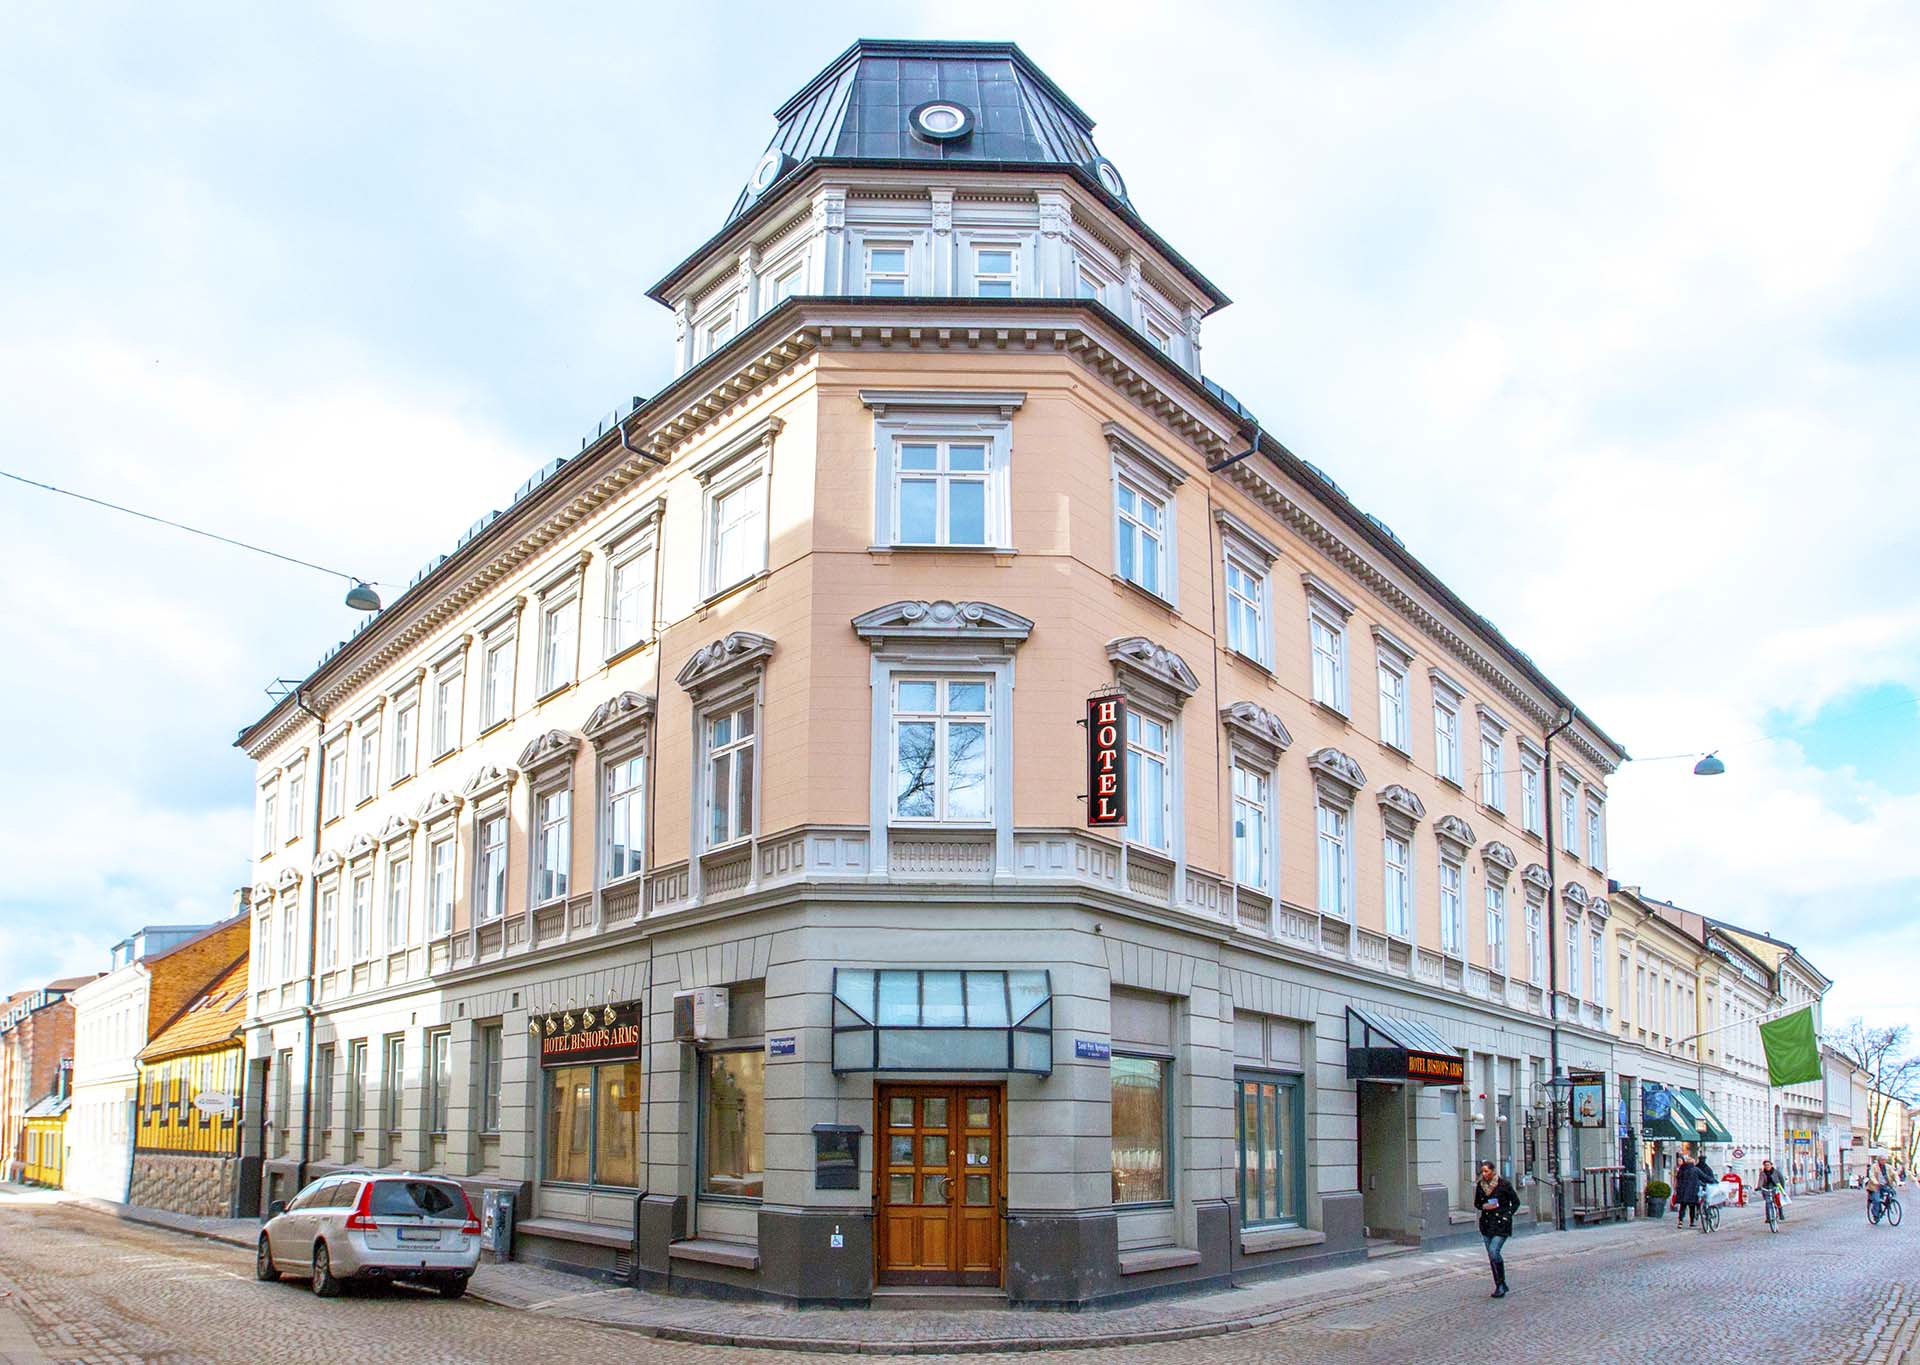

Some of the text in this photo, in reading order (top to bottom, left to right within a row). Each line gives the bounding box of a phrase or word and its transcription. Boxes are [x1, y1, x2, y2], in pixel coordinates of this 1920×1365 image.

[1097, 701, 1117, 819] HOTEL
[544, 1025, 639, 1053] HOTEL BISHOPS ARMS
[1409, 1056, 1463, 1077] HOTEL BISHOPS ARMS
